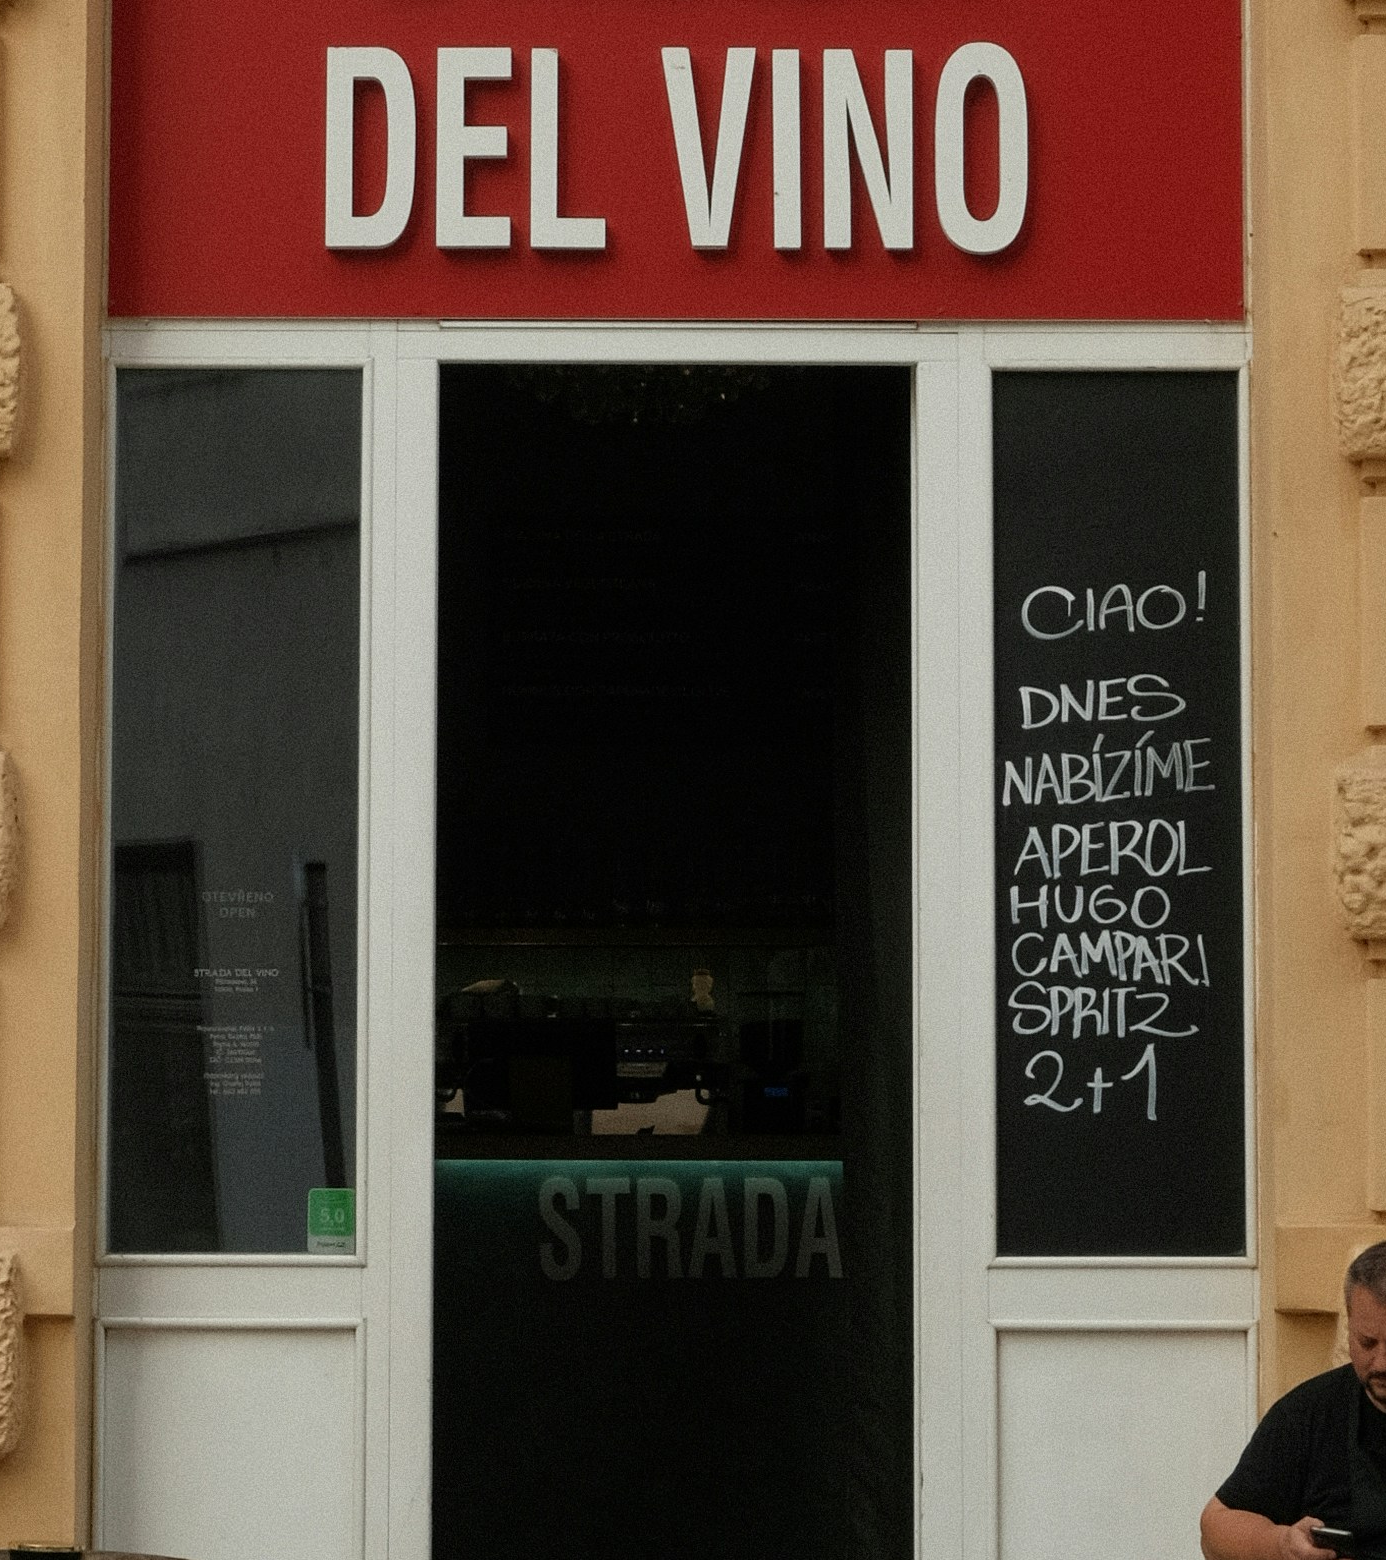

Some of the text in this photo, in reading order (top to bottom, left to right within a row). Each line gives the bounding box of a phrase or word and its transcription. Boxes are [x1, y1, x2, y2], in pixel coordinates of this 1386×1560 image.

[323, 40, 1030, 257] DEL VINO
[1018, 673, 1186, 730] DNES
[1002, 730, 1215, 806] NABÍZÍME
[1014, 818, 1212, 880] APEROL
[219, 907, 256, 918] OPEN
[1010, 883, 1171, 929] HUGO
[1011, 929, 1210, 987] CAMPARI
[1008, 981, 1199, 1039] SPRITZ
[538, 1176, 845, 1281] STRADA
